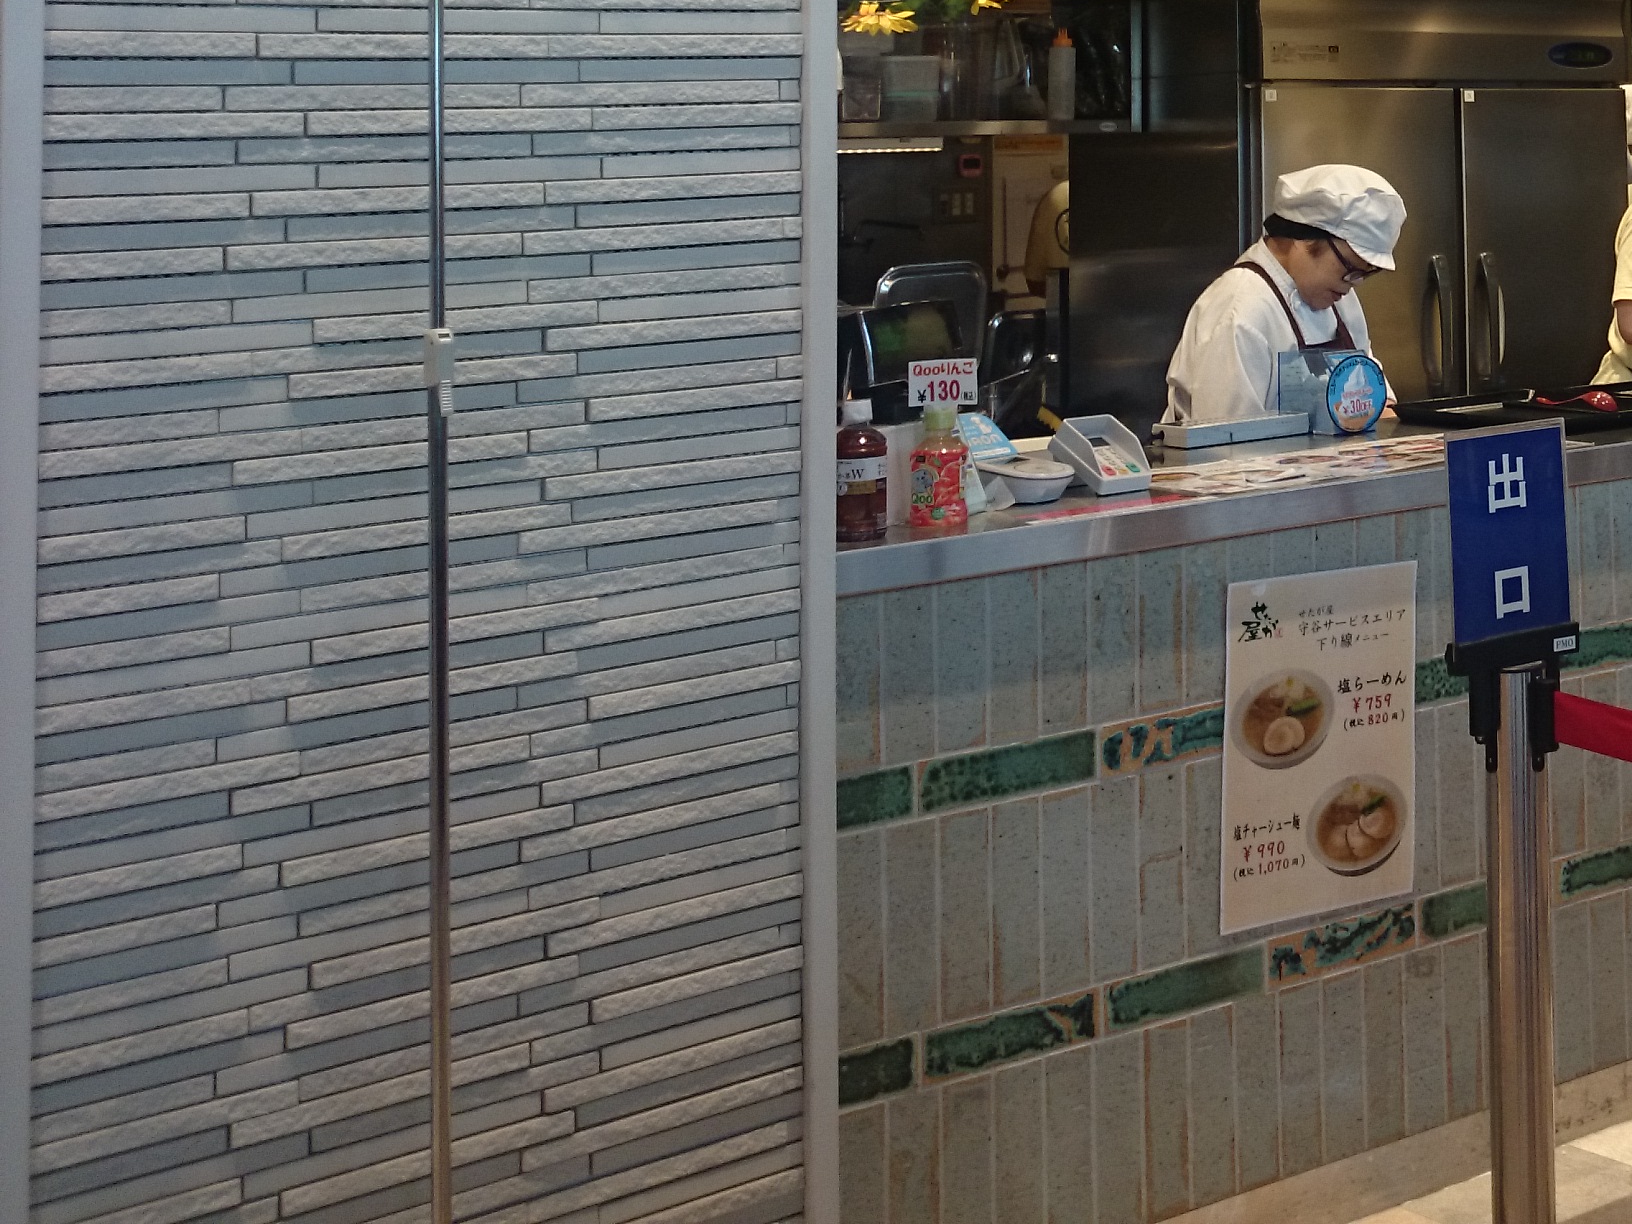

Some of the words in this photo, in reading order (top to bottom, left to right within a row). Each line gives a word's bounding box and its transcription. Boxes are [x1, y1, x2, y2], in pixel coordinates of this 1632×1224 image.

[912, 360, 974, 376] Qooりんご
[917, 379, 961, 403] ¥130
[1299, 609, 1406, 636] 守谷サービスエリア
[1556, 638, 1574, 650] PMO
[1337, 670, 1407, 695] 塩らーめん
